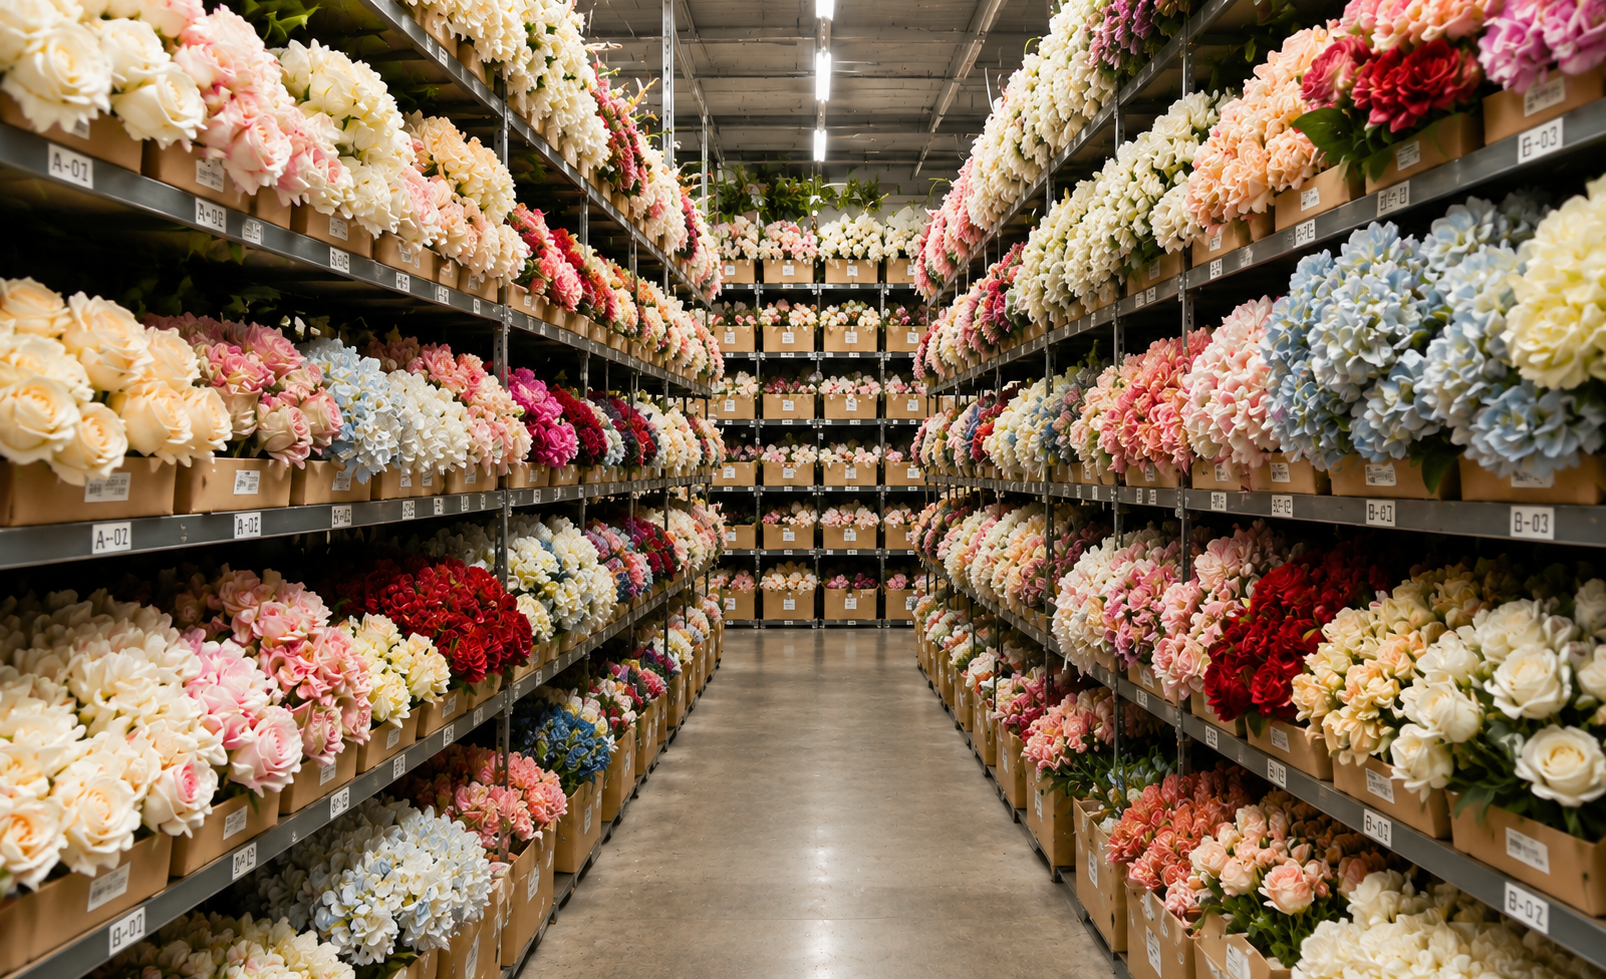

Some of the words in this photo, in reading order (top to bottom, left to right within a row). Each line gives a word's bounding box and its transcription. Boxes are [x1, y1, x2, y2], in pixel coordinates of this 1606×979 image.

[1514, 511, 1549, 534] B-03
[95, 527, 129, 550] A-02
[1508, 890, 1544, 927] B-02
